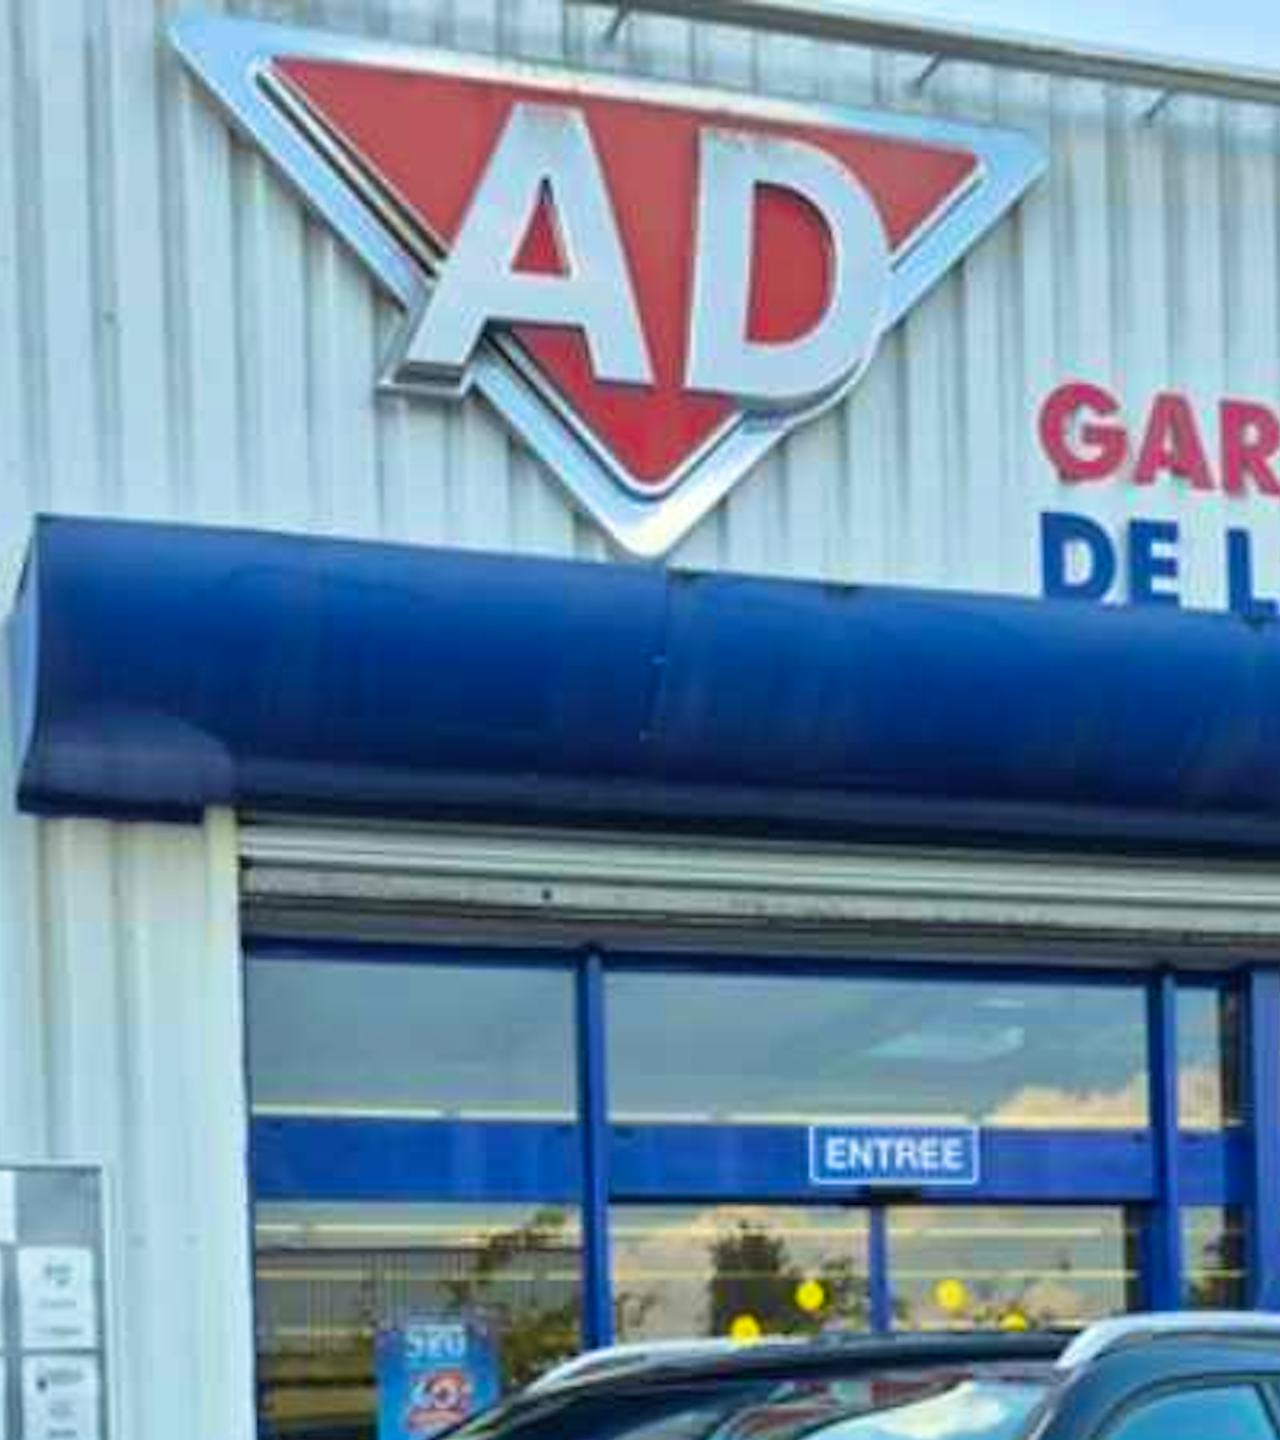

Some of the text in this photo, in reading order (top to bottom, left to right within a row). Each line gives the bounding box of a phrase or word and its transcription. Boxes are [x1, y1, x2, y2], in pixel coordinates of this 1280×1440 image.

[400, 100, 894, 399] AD
[1040, 511, 1179, 604] DE
[825, 1135, 964, 1171] ENTREE
